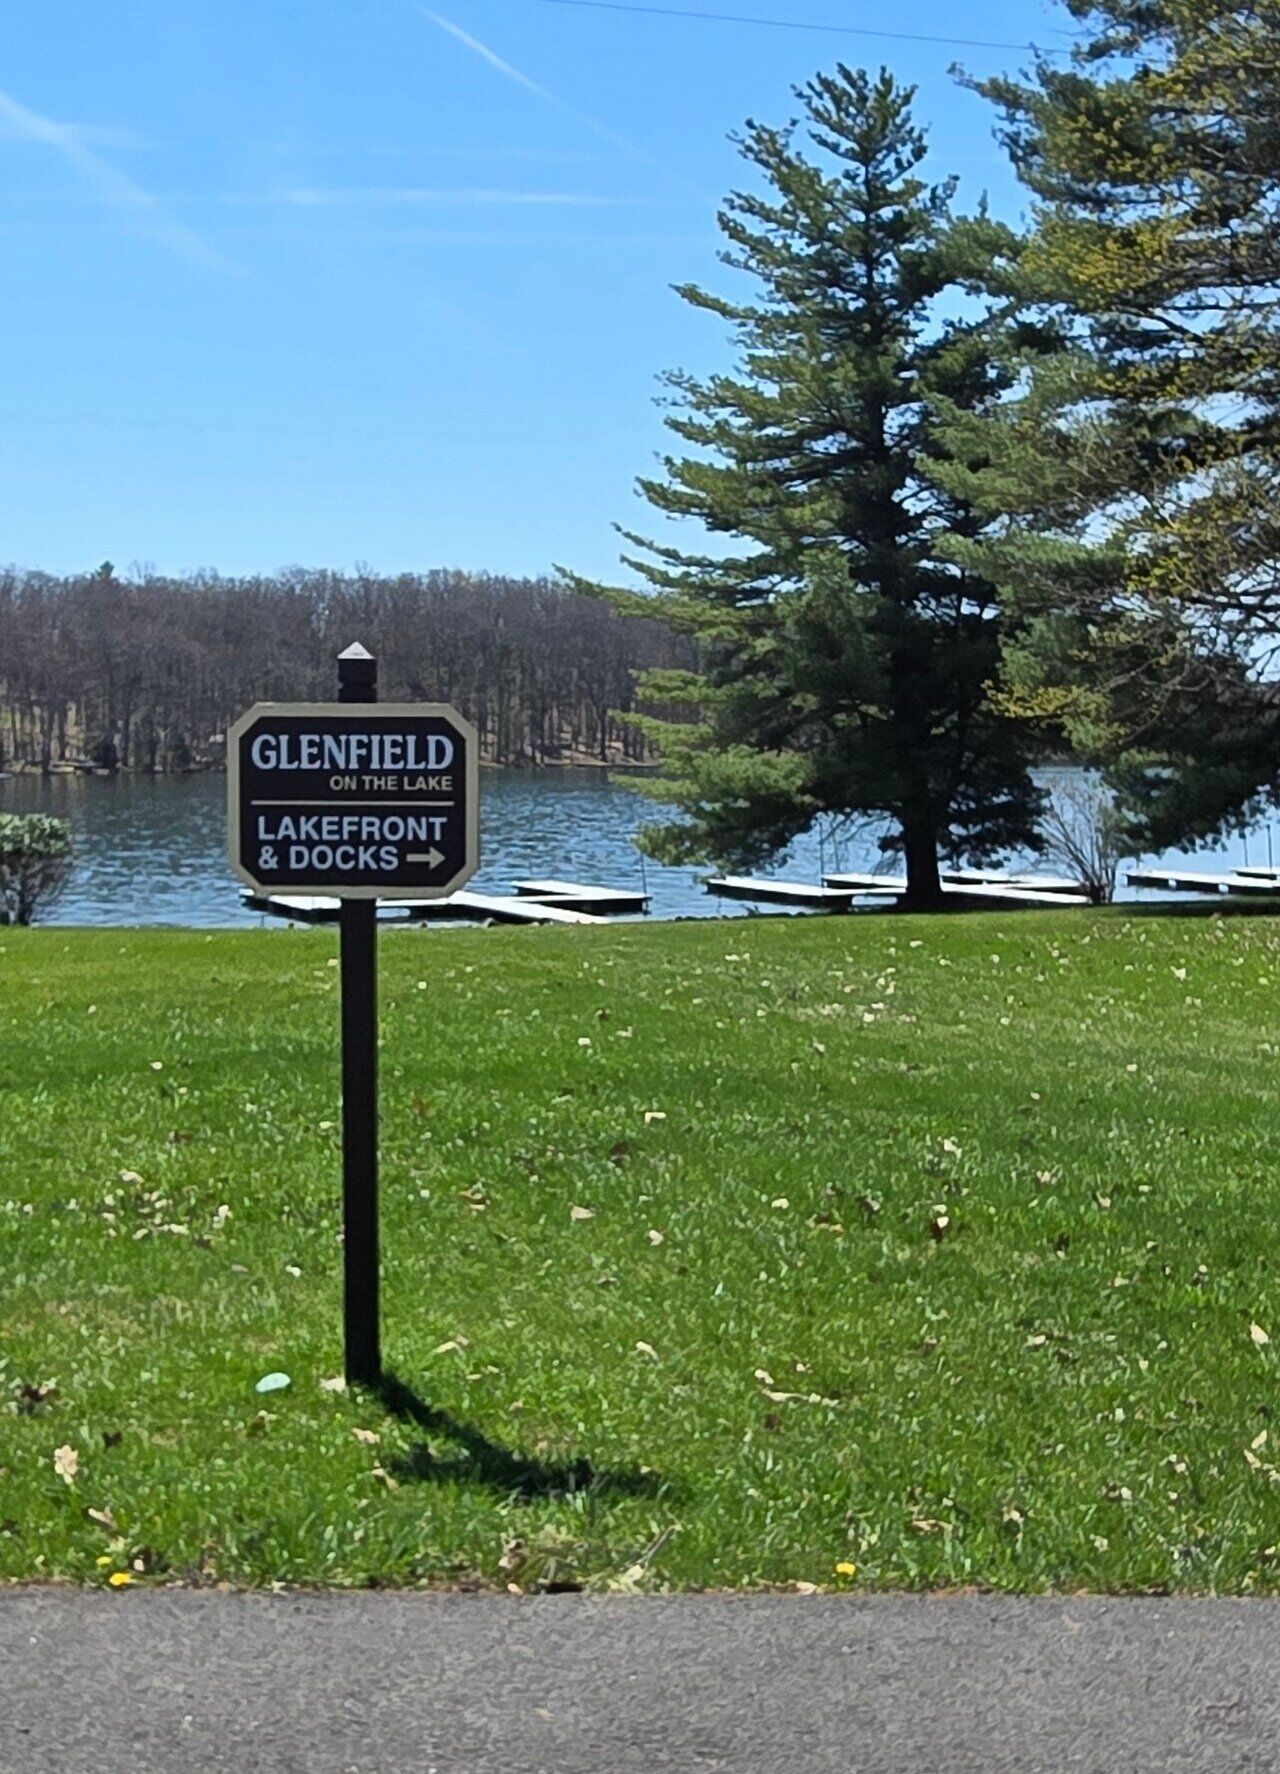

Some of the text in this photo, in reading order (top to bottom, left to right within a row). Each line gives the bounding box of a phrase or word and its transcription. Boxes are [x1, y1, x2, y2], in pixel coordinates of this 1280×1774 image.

[251, 734, 454, 770] GLENFIELD
[329, 775, 453, 791] ON THE LAKE
[258, 816, 448, 841] LAKEFRONT
[258, 845, 399, 870] & DOCKS
